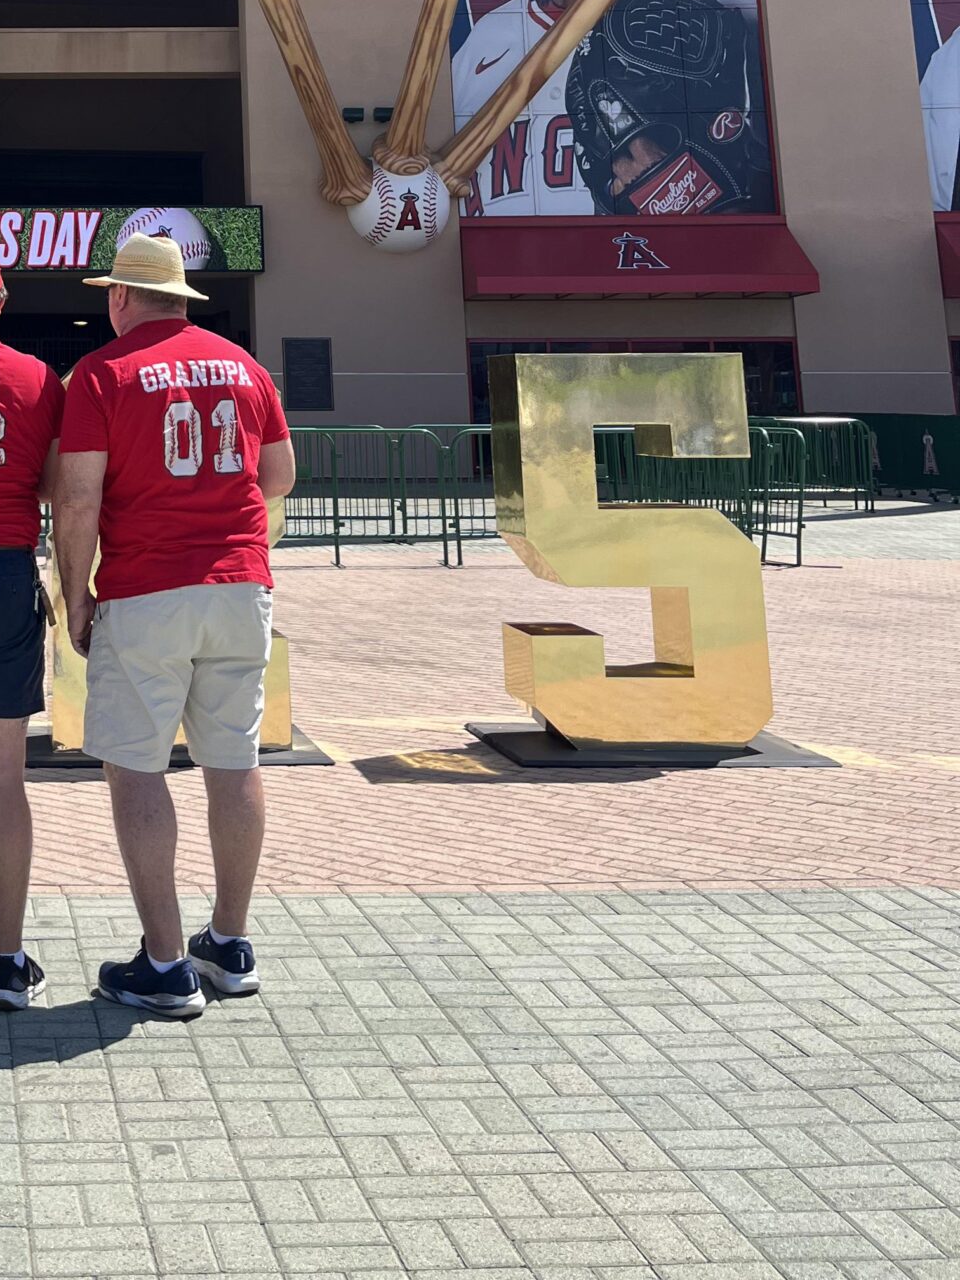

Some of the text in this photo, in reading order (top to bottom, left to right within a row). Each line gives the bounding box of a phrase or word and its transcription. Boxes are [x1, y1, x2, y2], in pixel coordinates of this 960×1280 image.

[648, 170, 698, 215] Rawlings
[27, 211, 102, 269] DAY
[138, 359, 254, 394] GRANDPA
[163, 398, 244, 477] 01
